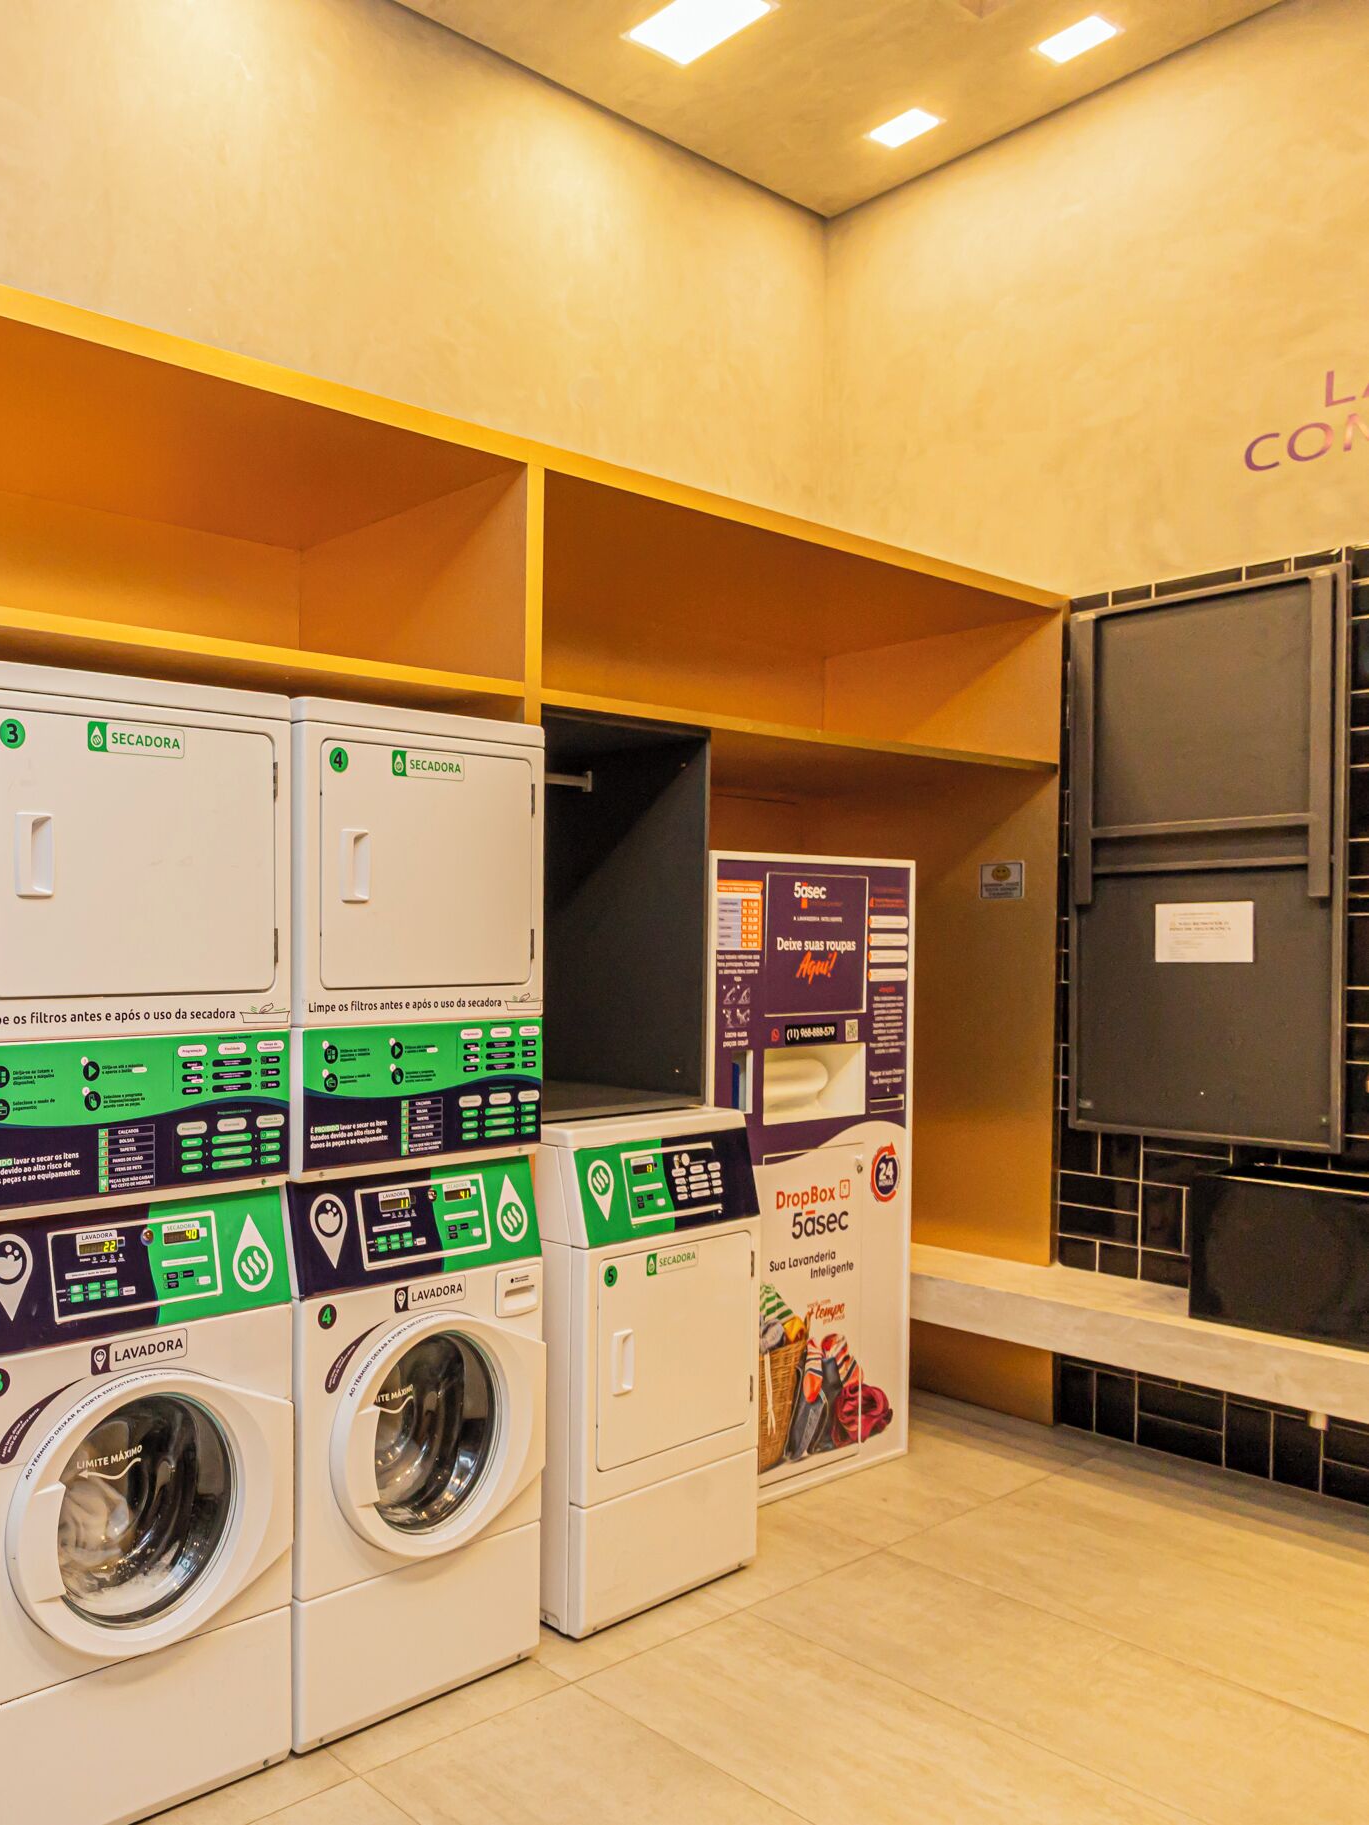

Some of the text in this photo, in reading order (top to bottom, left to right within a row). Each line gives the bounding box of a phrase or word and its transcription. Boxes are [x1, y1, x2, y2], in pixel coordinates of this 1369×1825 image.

[1325, 370, 1369, 407] L
[6, 723, 18, 743] 3
[111, 732, 180, 749] SECADORA
[333, 751, 342, 768] 4
[410, 759, 461, 773] SECADORA
[777, 937, 856, 954] Deixe suas roupas
[796, 951, 838, 985] Aqui!
[308, 1002, 335, 1014] Limpe
[338, 1003, 348, 1011] os
[351, 1000, 377, 1011] filtros
[379, 1001, 403, 1010] antes
[405, 1001, 410, 1009] e
[412, 998, 431, 1010] após
[440, 1000, 454, 1008] uso
[456, 998, 465, 1007] da
[468, 997, 501, 1007] secadora
[13, 1015, 26, 1024] os
[30, 1012, 67, 1023] filtros
[70, 1011, 101, 1022] antes
[105, 1012, 111, 1021] e
[114, 1009, 140, 1023] após
[143, 1011, 150, 1020] o
[153, 1011, 171, 1019] uso
[174, 1008, 187, 1019] da
[190, 1008, 235, 1019] secadora
[879, 1161, 894, 1180] 24
[776, 1186, 835, 1209] DropBox
[82, 1232, 113, 1241] LAVADORA
[104, 1241, 116, 1252] 22
[659, 1251, 695, 1267] SECADORA
[769, 1250, 835, 1272] Sua Lavanderia
[608, 1269, 613, 1283] 5
[810, 1260, 854, 1278] Inteligente
[412, 1283, 462, 1302] LAVADORA
[322, 1308, 331, 1324] 4
[115, 1338, 183, 1362] LAVADORA
[76, 1445, 142, 1470] LIMITE MÁXIMO
